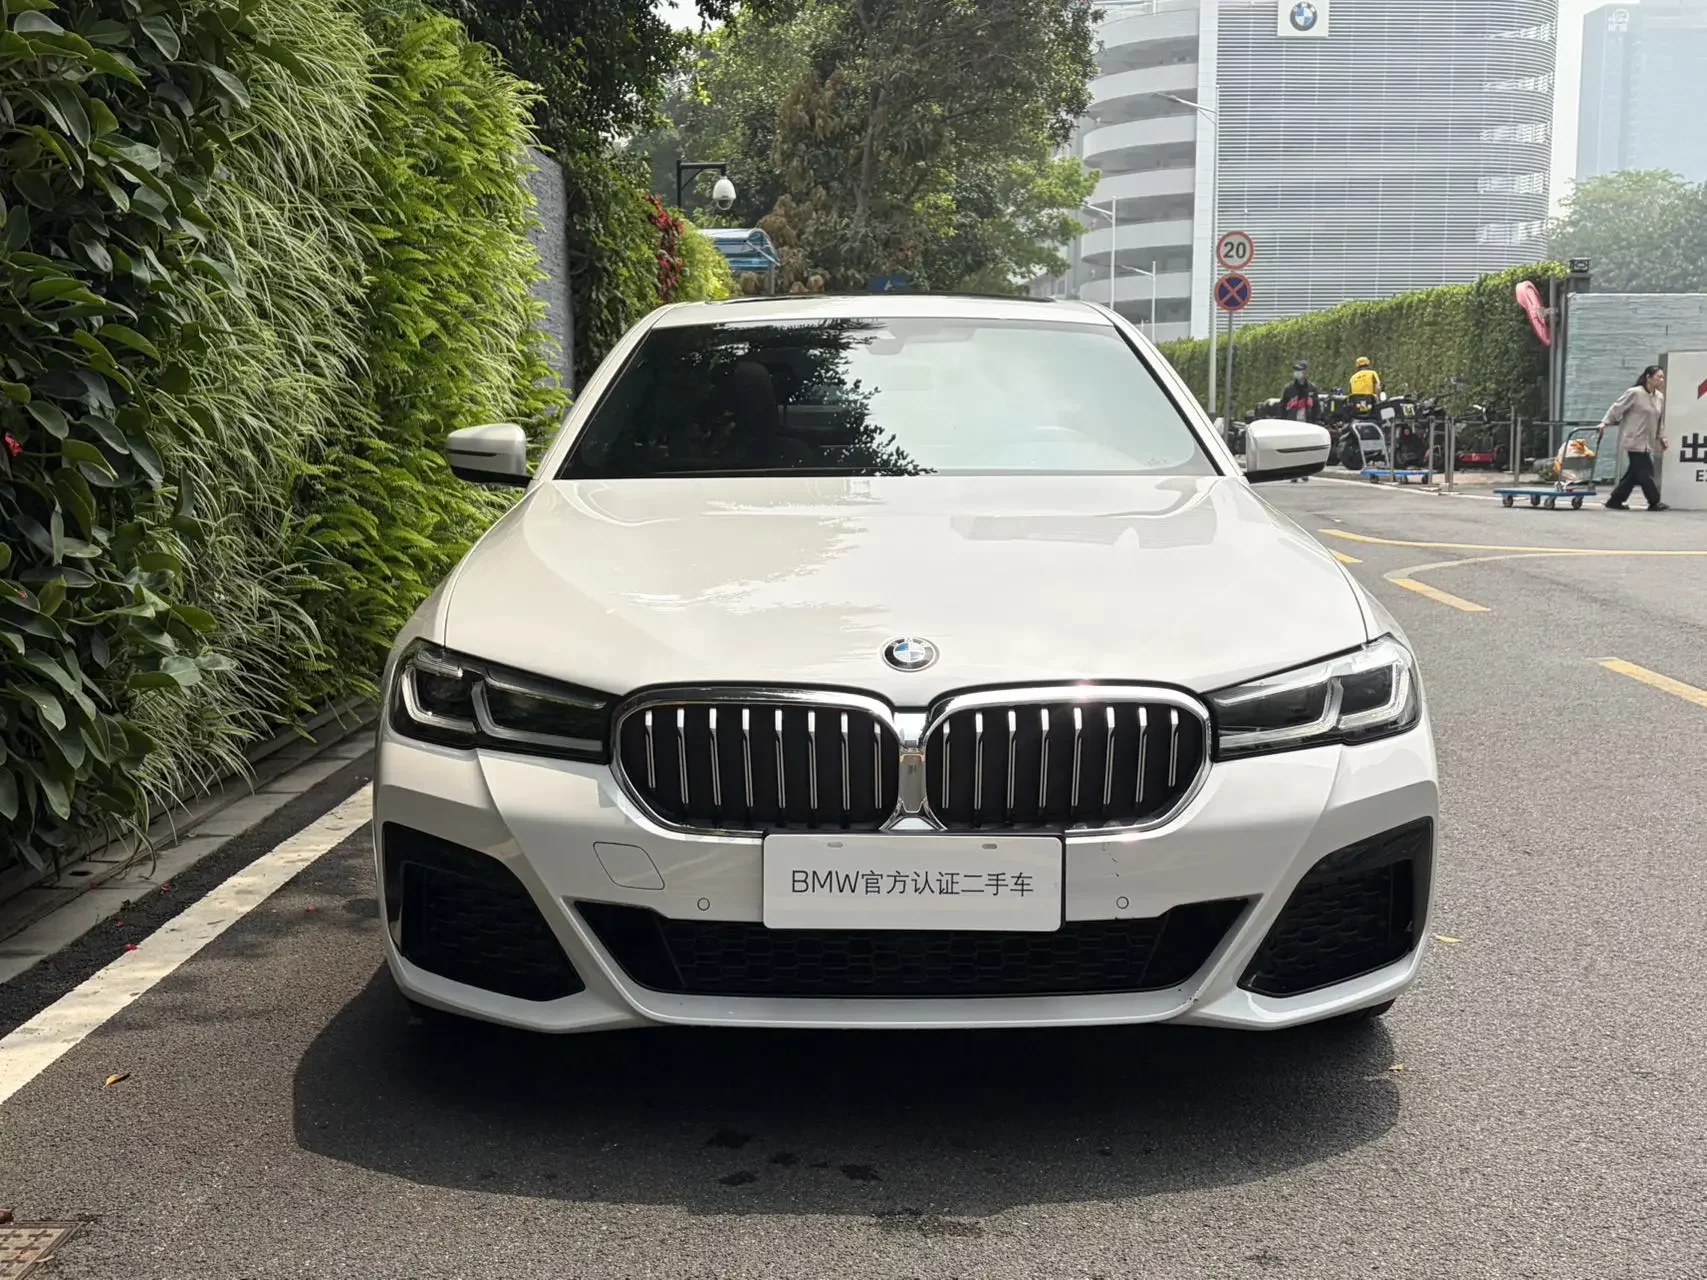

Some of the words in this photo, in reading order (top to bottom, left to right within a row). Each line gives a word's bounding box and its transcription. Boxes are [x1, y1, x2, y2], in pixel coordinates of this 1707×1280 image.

[1223, 241, 1246, 259] 20
[1695, 469, 1707, 482] E
[791, 869, 1034, 897] BMW官方认证二手车
